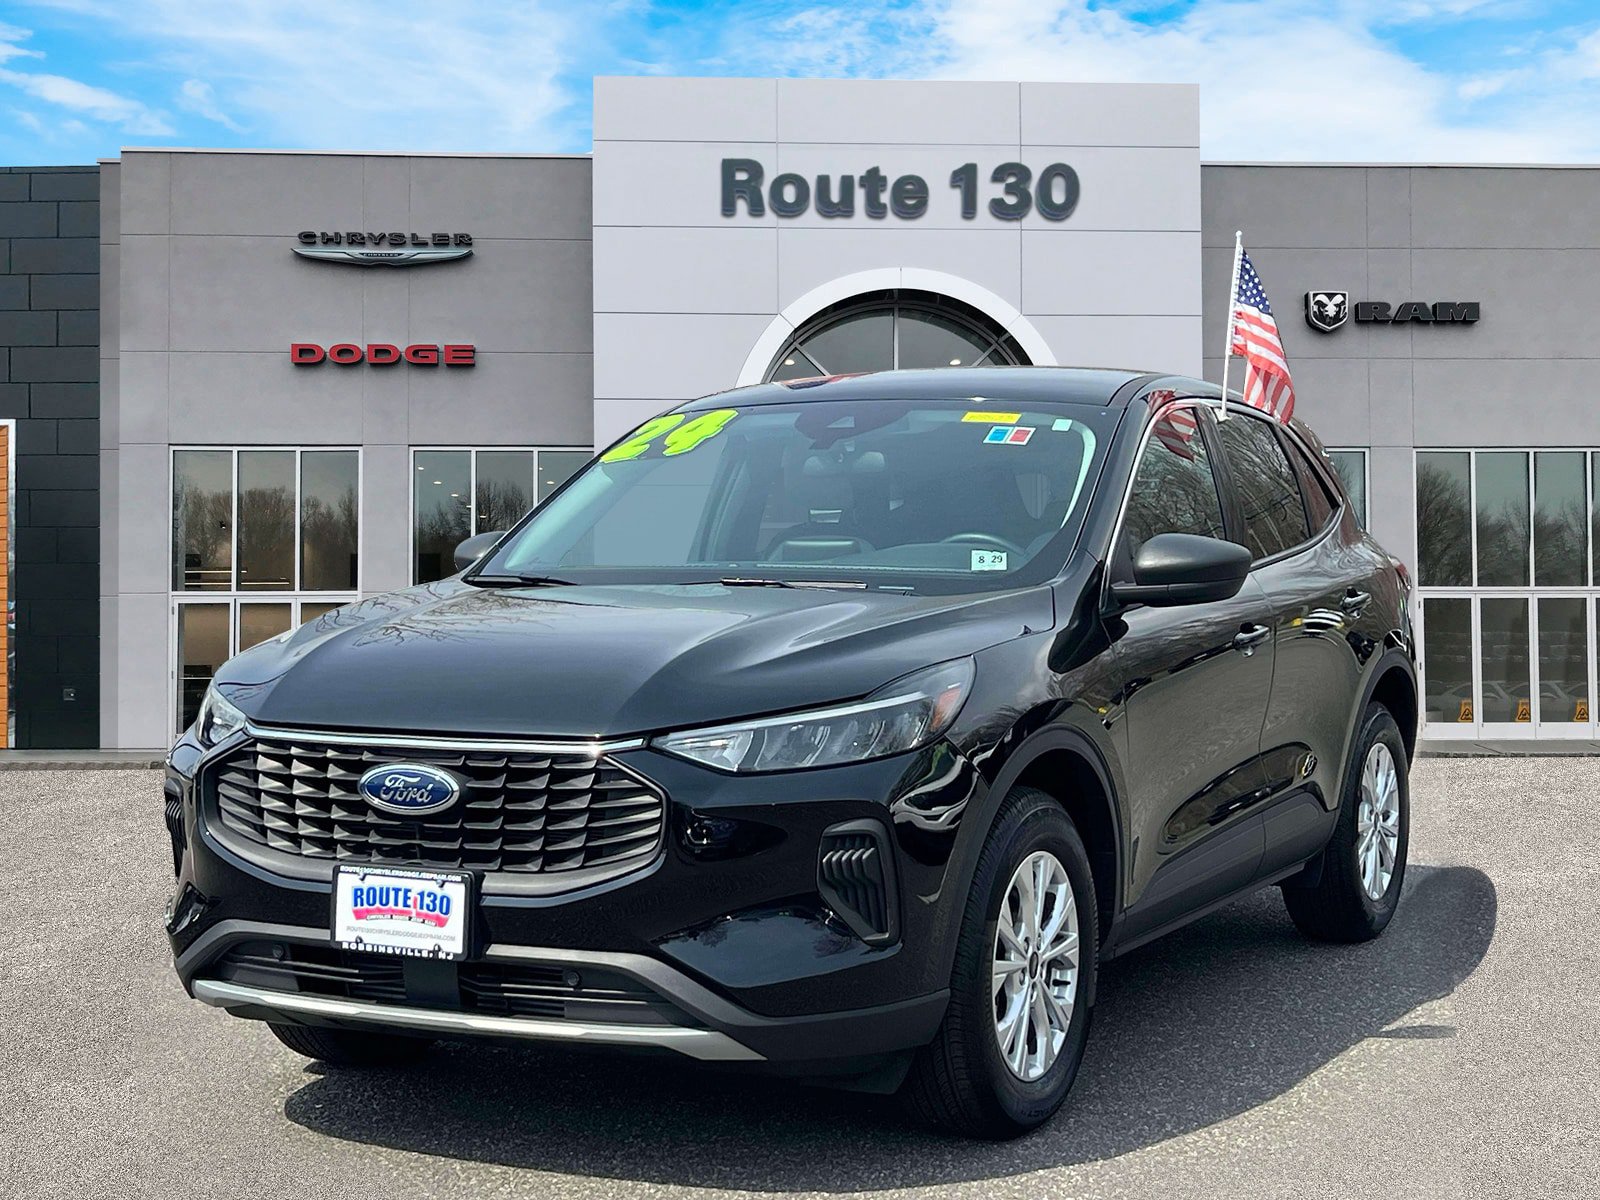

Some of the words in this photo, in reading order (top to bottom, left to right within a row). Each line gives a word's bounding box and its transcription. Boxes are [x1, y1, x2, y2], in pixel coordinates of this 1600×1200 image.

[720, 158, 930, 218] Route
[950, 162, 1081, 221] 130
[298, 231, 473, 246] CHRYSLER
[1355, 302, 1480, 323] RAM
[291, 344, 476, 366] DODGE
[991, 555, 1003, 563] 29
[380, 774, 434, 803] Ford
[353, 886, 412, 908] ROUTE
[417, 890, 451, 916] 130
[438, 950, 454, 960] NJ
